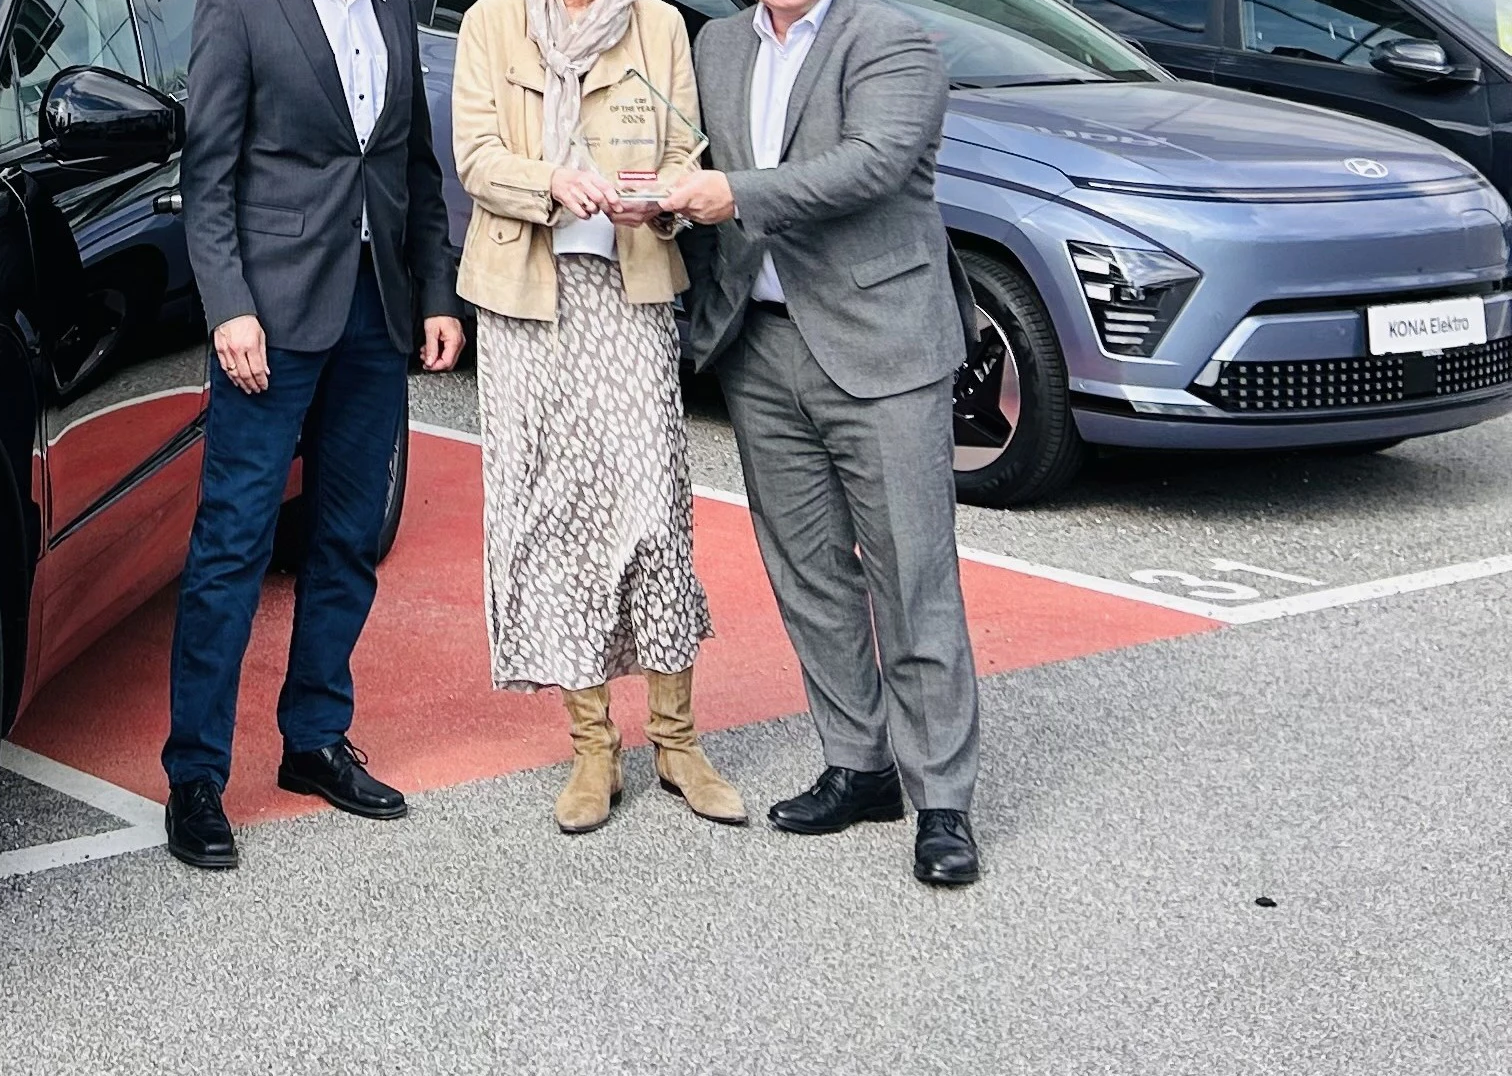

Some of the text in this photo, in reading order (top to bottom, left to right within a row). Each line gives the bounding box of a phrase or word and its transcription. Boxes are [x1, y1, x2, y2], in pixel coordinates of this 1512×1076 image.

[636, 105, 656, 113] YEAR
[1388, 315, 1470, 338] KONA Elektro
